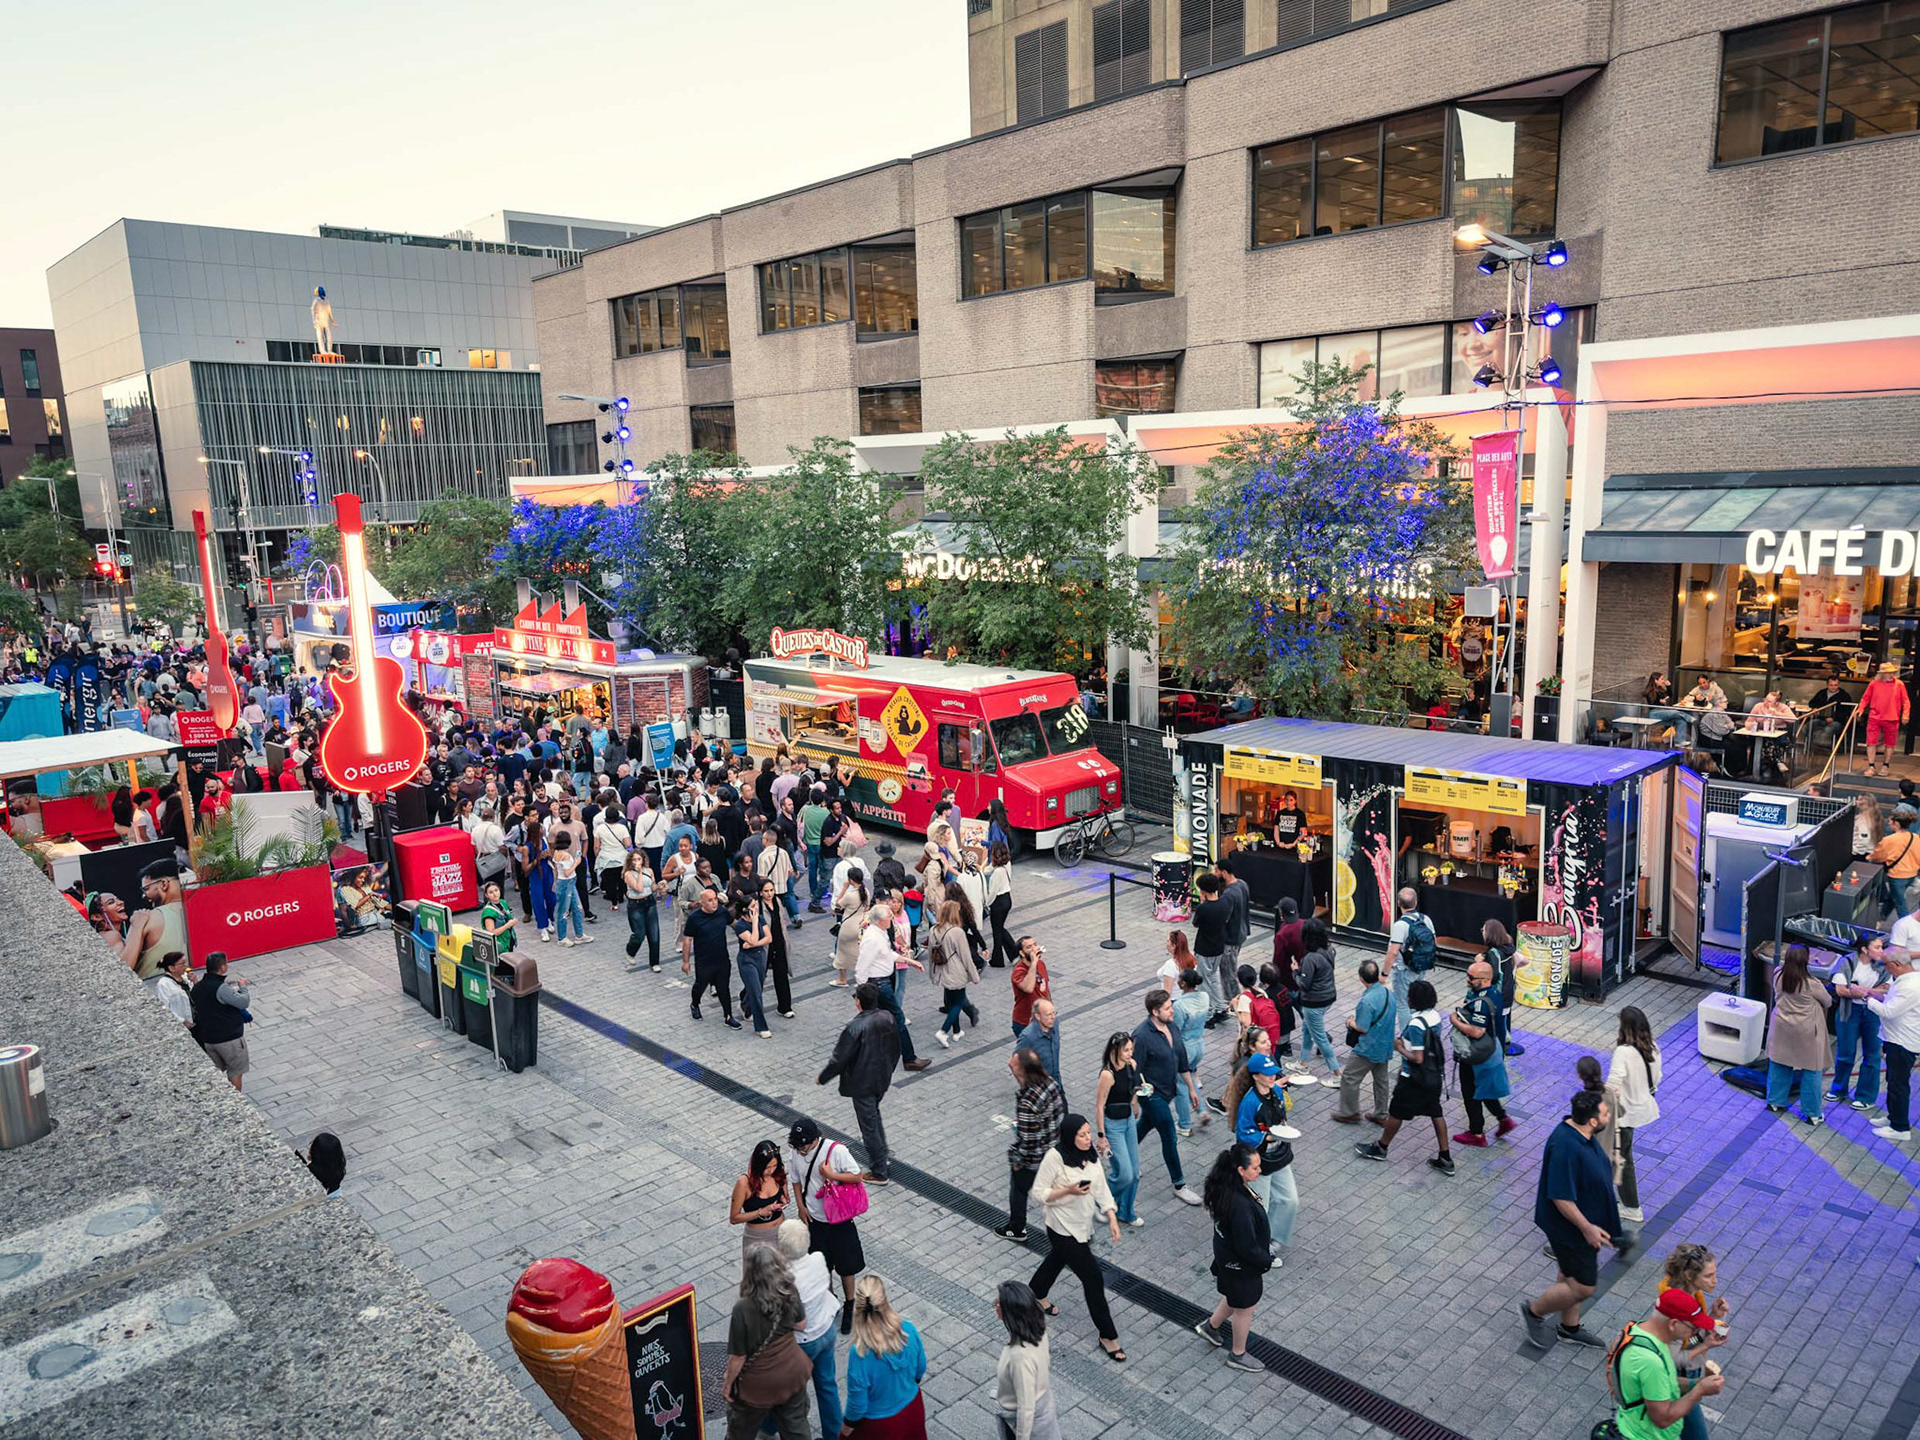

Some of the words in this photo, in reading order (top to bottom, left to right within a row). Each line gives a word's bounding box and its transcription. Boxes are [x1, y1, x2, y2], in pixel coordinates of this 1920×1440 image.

[1476, 453, 1491, 463] PLACE
[1491, 452, 1501, 462] DES
[1501, 451, 1512, 461] ARTS
[1491, 468, 1499, 515] SPECTACLES
[1487, 495, 1495, 533] QUARTIER
[1745, 523, 1866, 576] CAFÉ
[1878, 529, 1920, 578] D
[378, 609, 441, 628] BOUTIQUE
[771, 629, 814, 657] QUEUES
[822, 631, 866, 668] CASTOR
[81, 672, 97, 733] nergir
[190, 715, 215, 723] ROGE
[359, 759, 411, 777] ROGERS
[862, 803, 906, 823] APPÉTIT!
[1191, 762, 1209, 868] LIMONADE
[1745, 803, 1781, 813] MONSIEUR
[1753, 811, 1779, 819] GLACE
[433, 872, 463, 887] JAZZ
[1543, 812, 1586, 951] Sangria
[243, 900, 300, 922] ROGERS
[1550, 940, 1563, 1006] LIMONADE
[635, 1352, 670, 1378] OUVERTS
[636, 1346, 665, 1368] SOMMES
